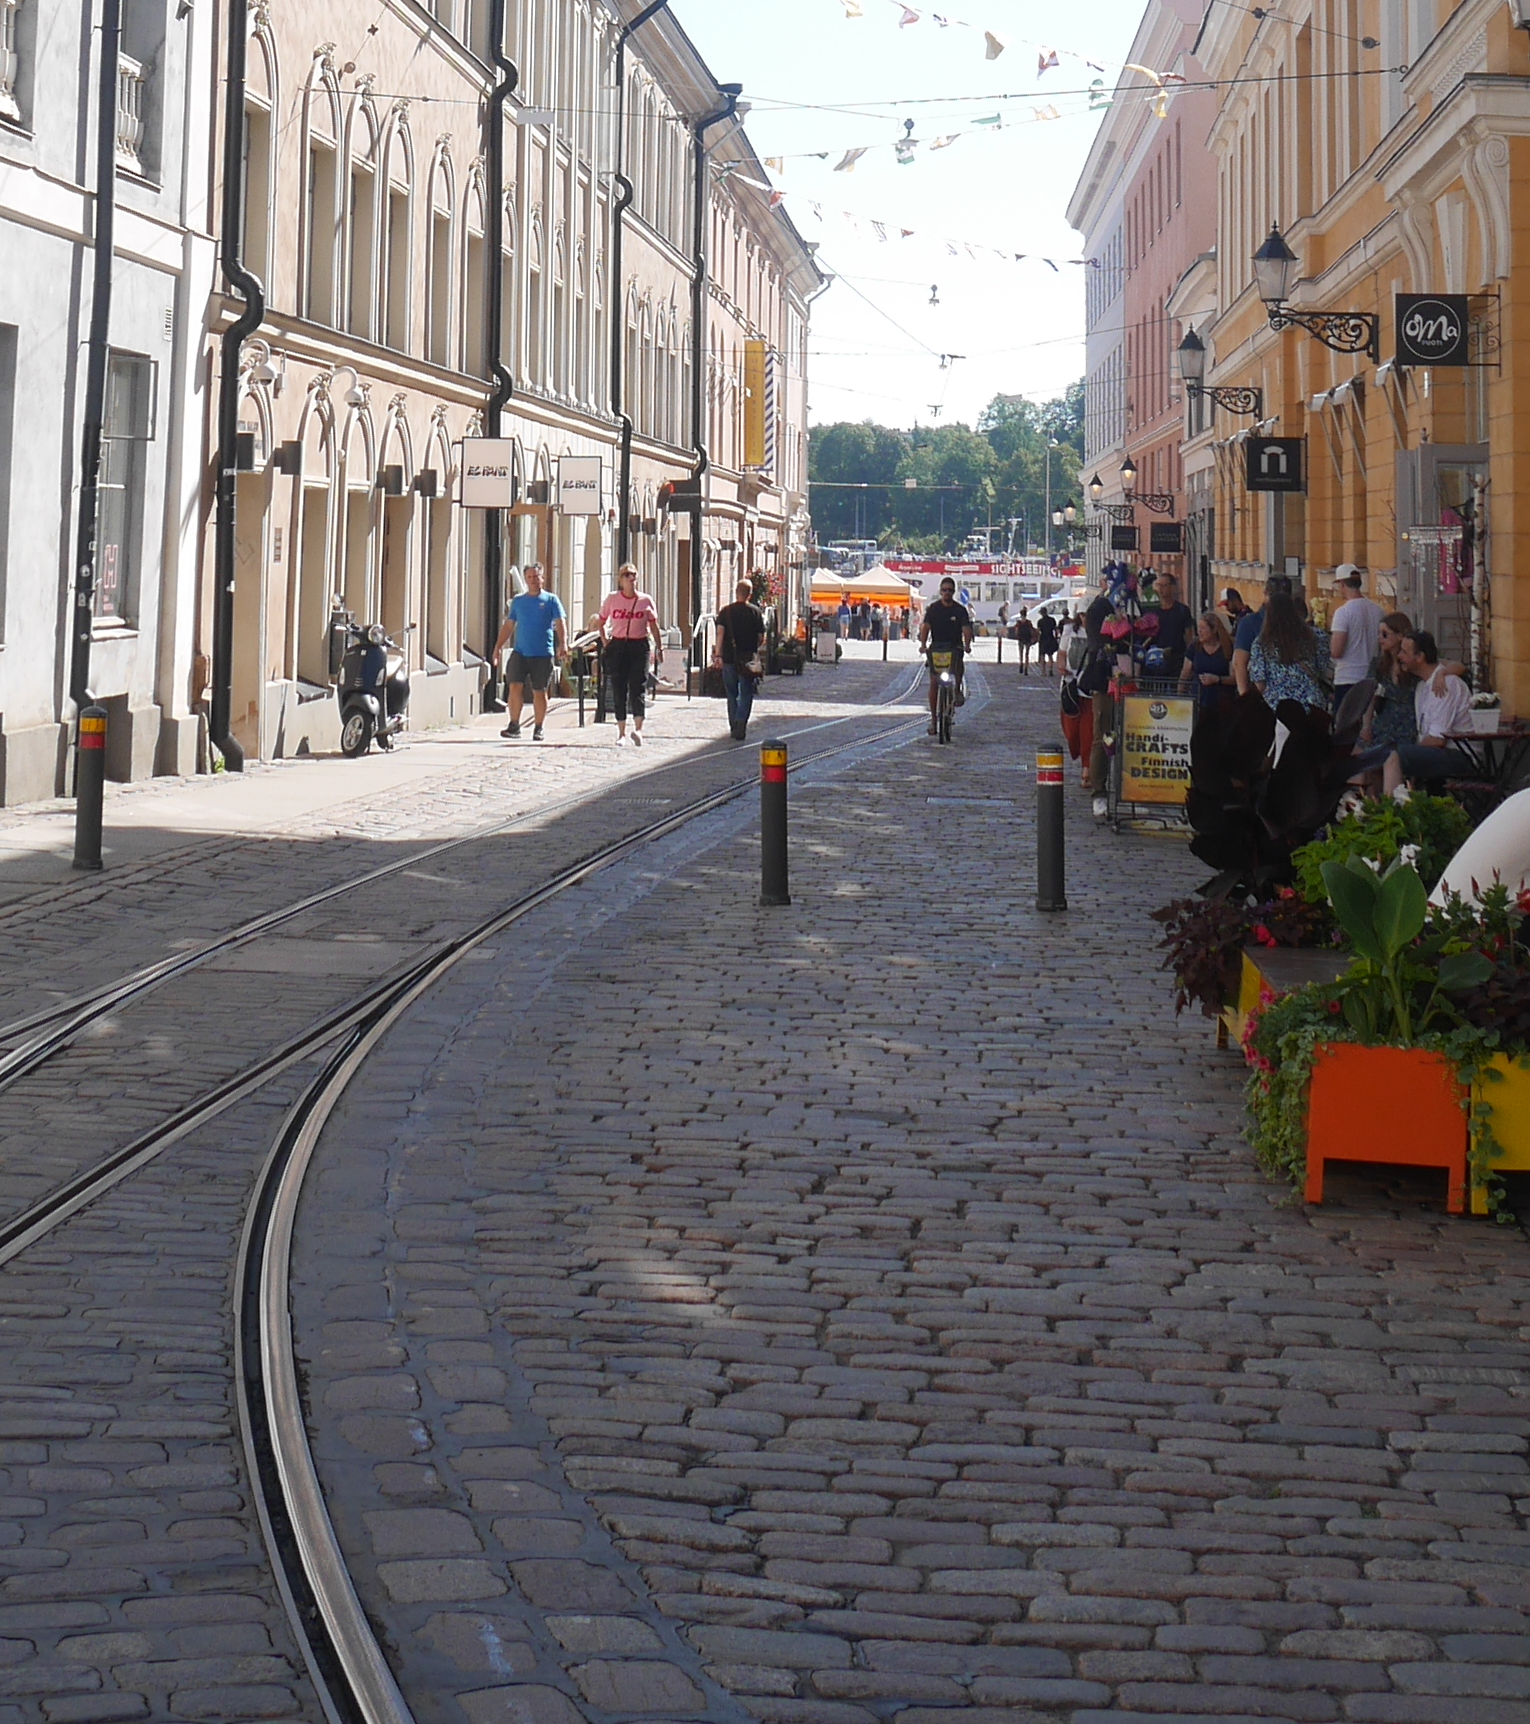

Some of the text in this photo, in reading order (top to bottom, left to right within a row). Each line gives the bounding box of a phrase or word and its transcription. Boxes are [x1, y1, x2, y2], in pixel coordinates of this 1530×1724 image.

[612, 608, 645, 620] Ciao
[1126, 732, 1169, 744] Handi-
[1126, 741, 1188, 755] CRAFTS
[1141, 757, 1188, 768] Finnish
[1131, 766, 1188, 780] DESIGN
